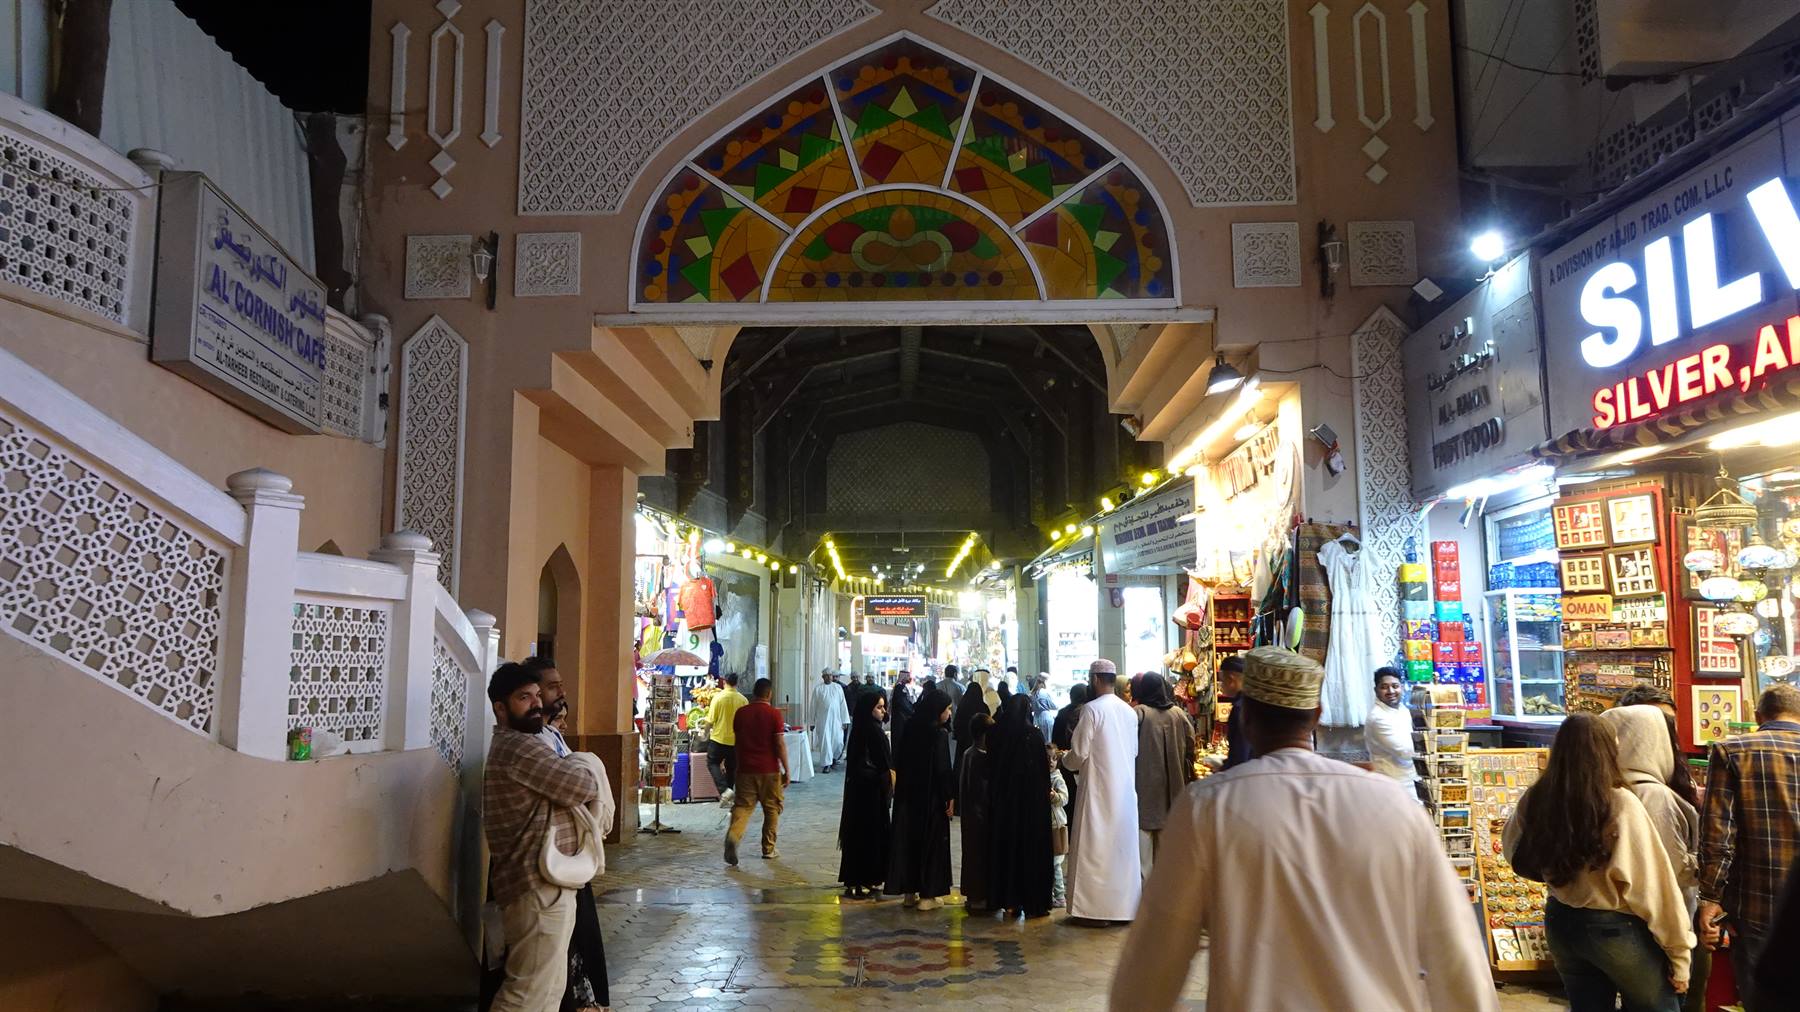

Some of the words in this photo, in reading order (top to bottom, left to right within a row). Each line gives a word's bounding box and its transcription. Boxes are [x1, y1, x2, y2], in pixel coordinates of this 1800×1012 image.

[1549, 268, 1556, 285] A
[1556, 246, 1594, 282] DIVISION
[1595, 239, 1607, 259] OF
[1640, 202, 1672, 234] TRAD.
[1674, 185, 1702, 216] COM.
[1704, 166, 1734, 200] L.L.C
[209, 263, 230, 305] AL
[234, 280, 294, 350] CORNISH
[296, 326, 327, 371] CAFE
[1566, 602, 1607, 615] OMAN
[1630, 597, 1651, 608] LOVE
[1621, 608, 1657, 620] OMAN
[689, 634, 700, 650] 9
